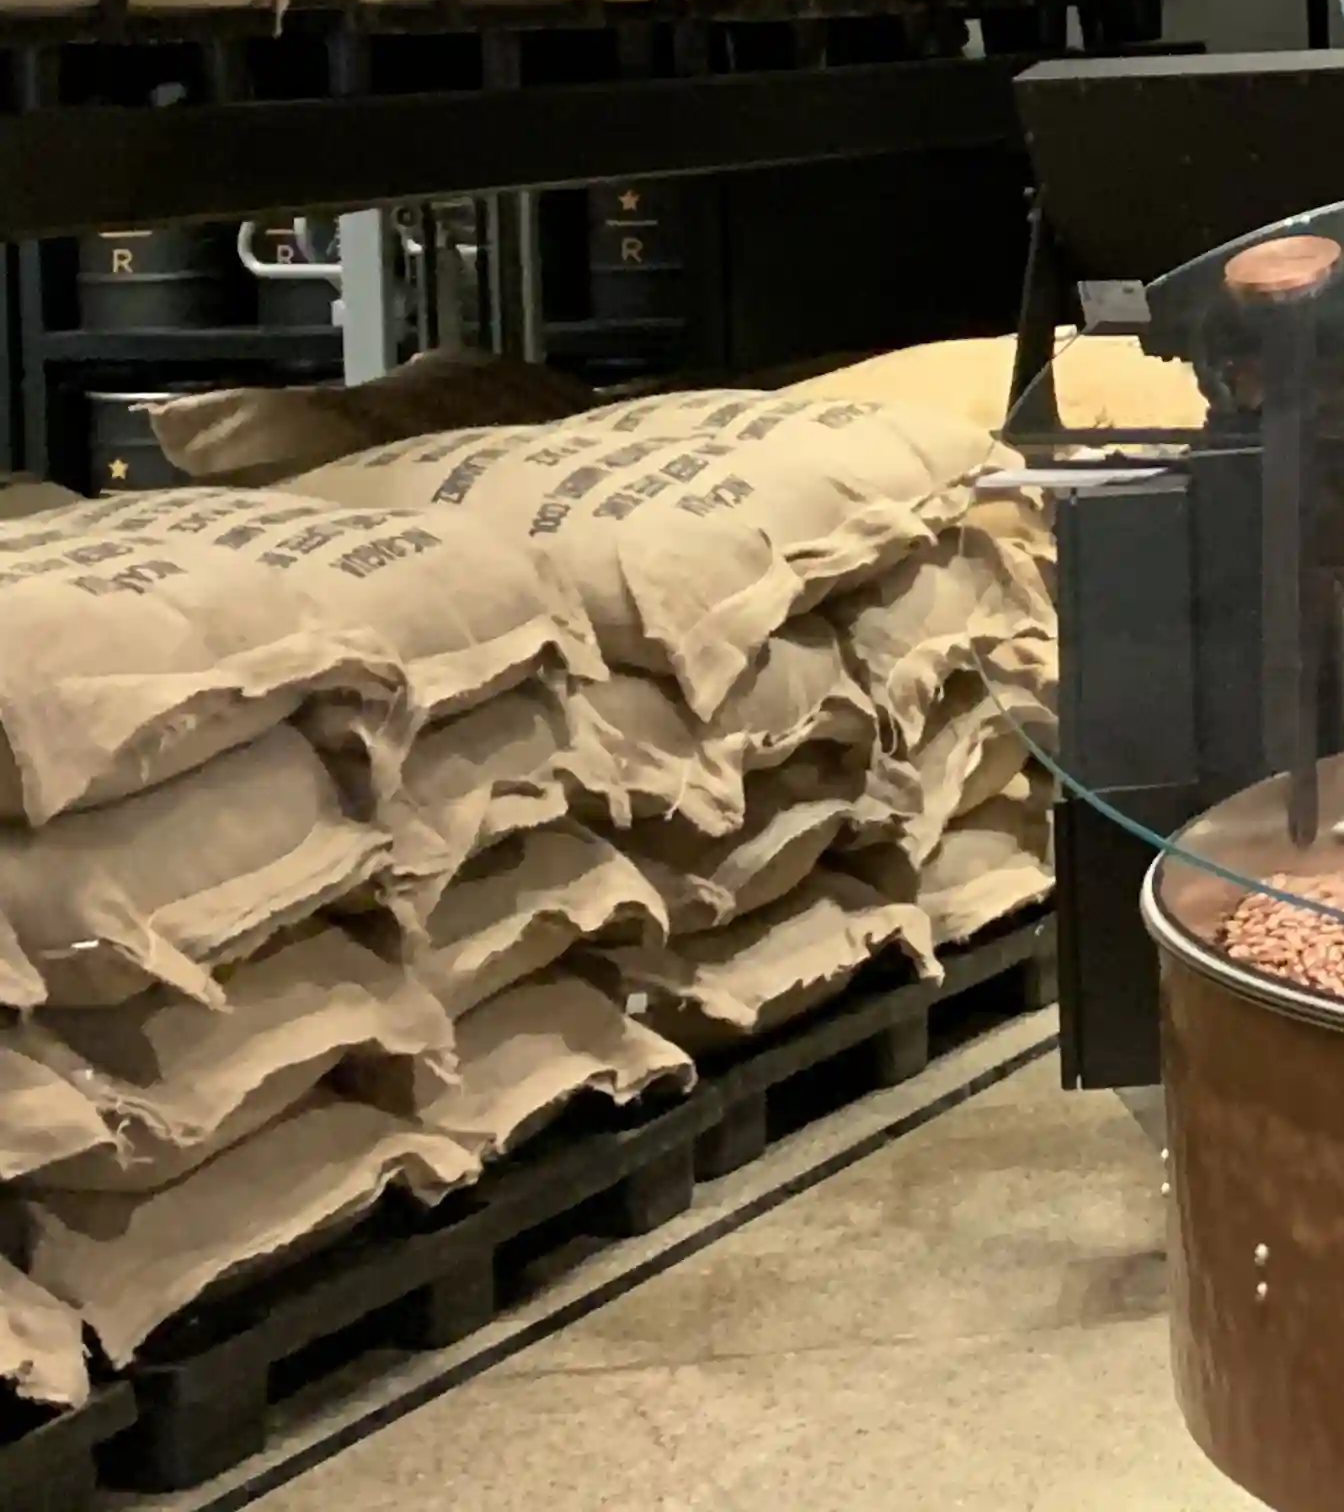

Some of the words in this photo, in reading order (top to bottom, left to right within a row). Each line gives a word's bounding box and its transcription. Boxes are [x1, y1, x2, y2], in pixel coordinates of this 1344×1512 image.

[112, 248, 134, 274] R
[276, 244, 294, 264] R
[622, 237, 643, 263] R
